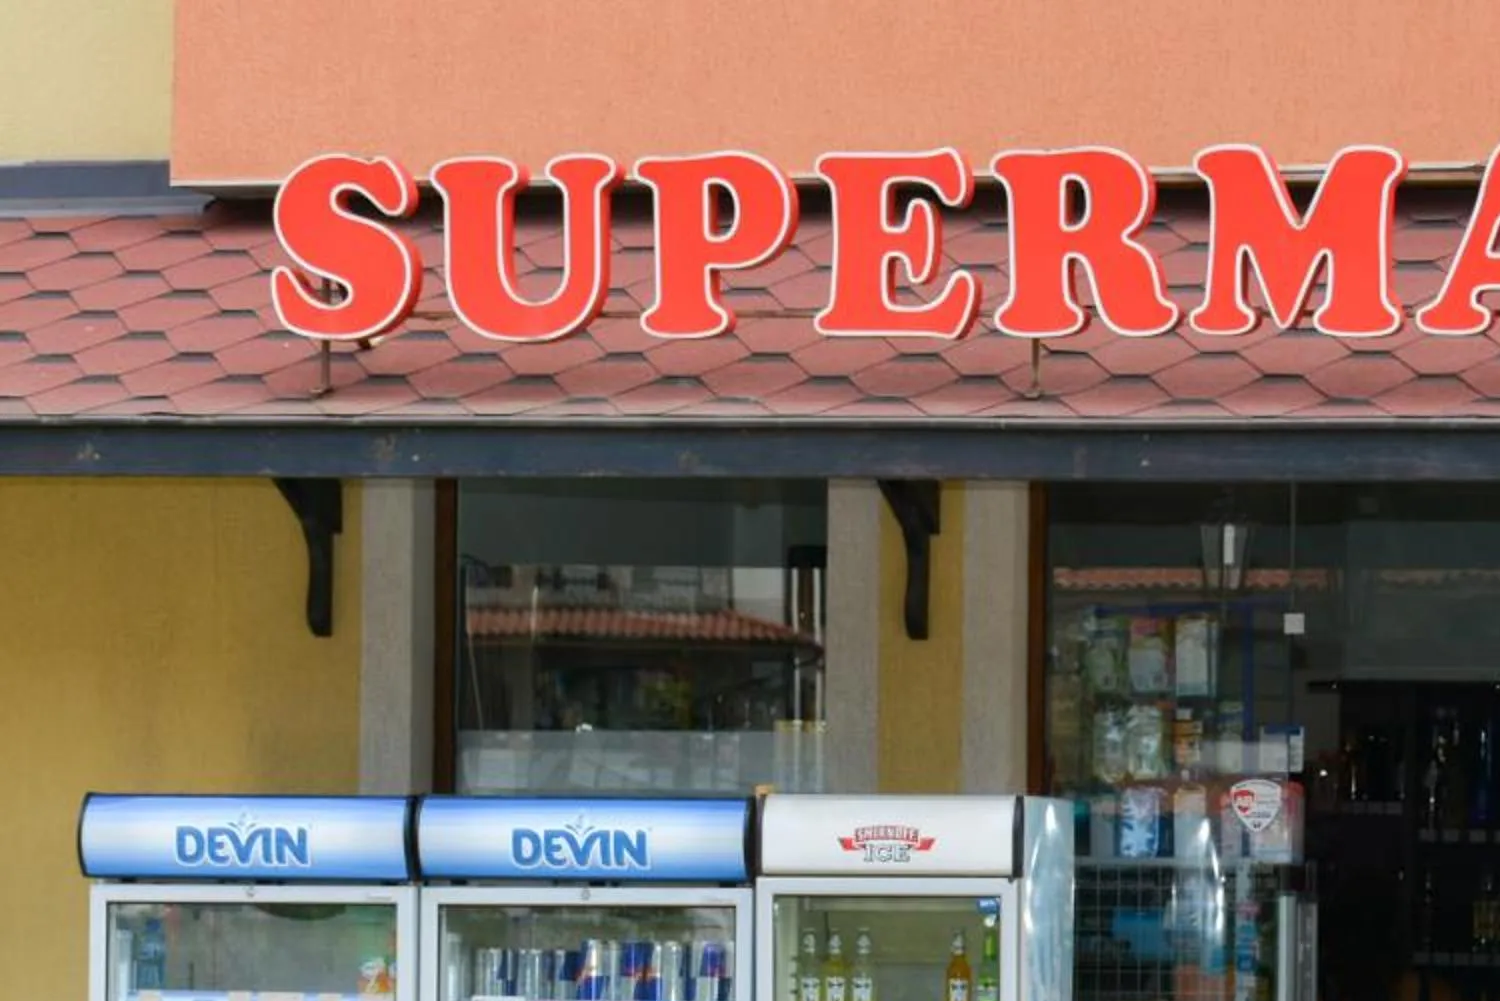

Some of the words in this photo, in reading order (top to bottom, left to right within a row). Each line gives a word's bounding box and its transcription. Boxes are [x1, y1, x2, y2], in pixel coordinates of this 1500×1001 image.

[175, 824, 310, 867] DEVIN
[511, 827, 650, 869] DEVIN
[863, 843, 911, 863] ICE
